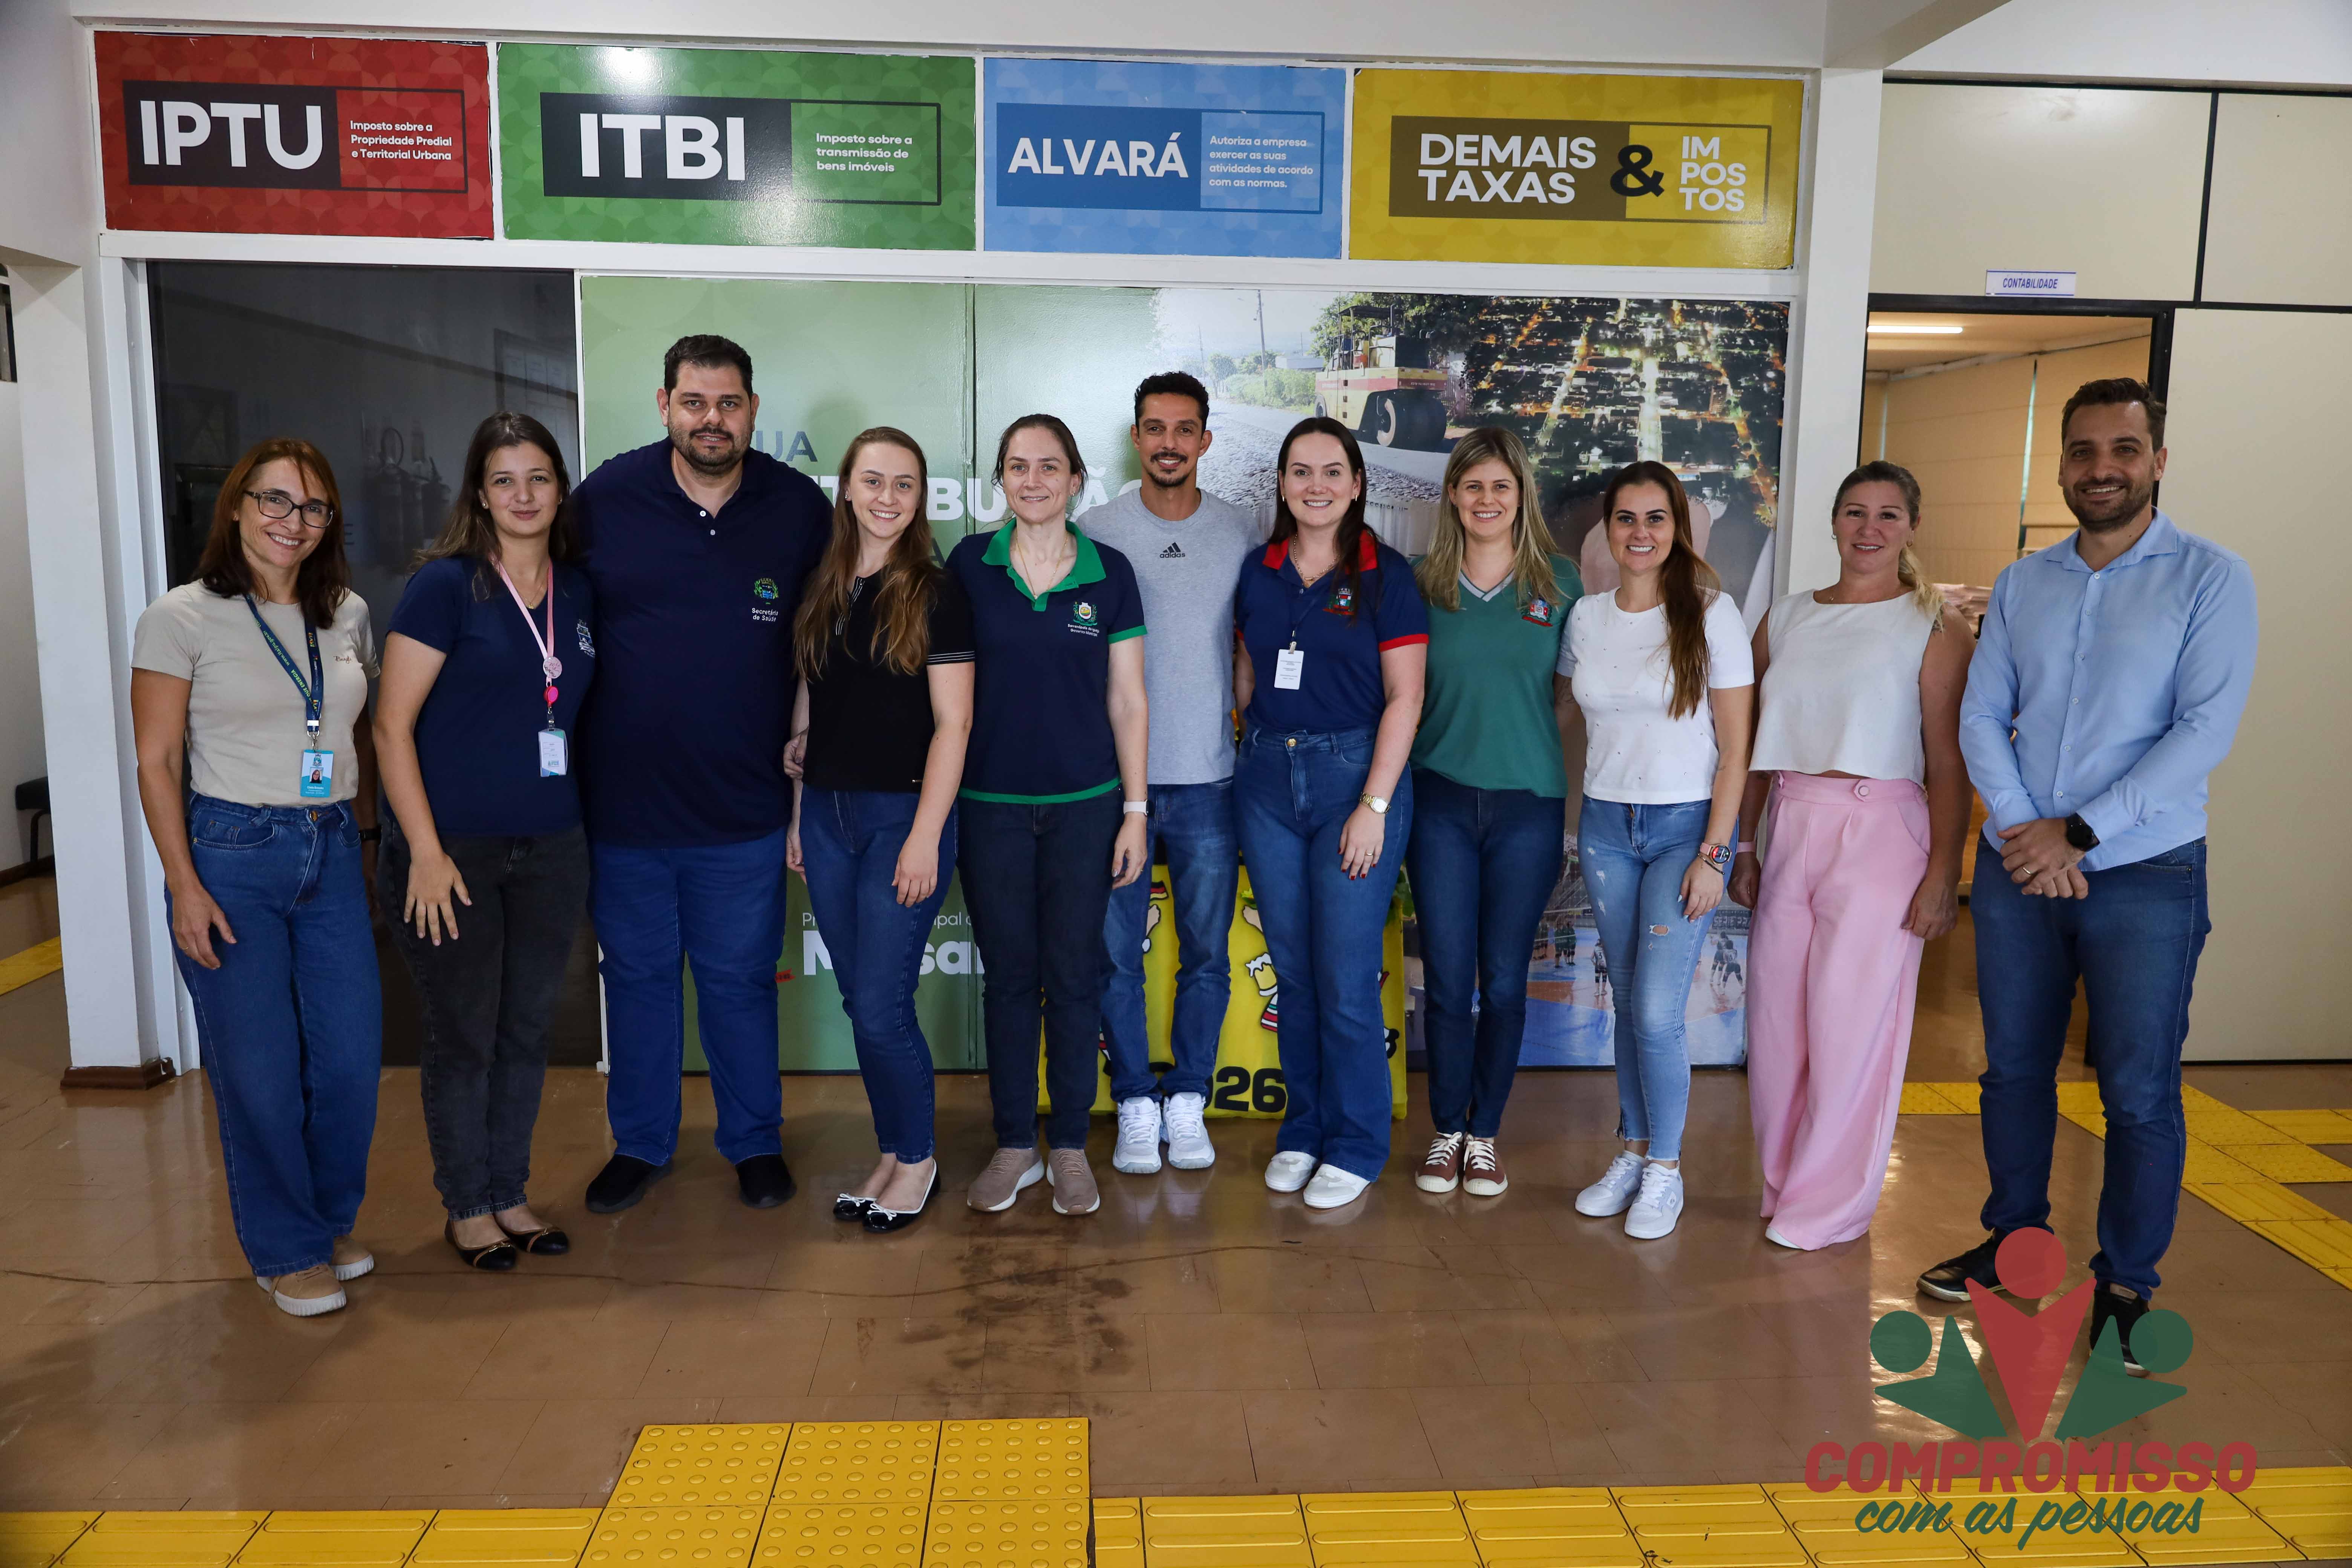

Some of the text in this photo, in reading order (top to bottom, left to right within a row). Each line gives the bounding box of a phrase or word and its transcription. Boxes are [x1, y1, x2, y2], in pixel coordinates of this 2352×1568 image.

[141, 101, 322, 169] IPTU
[351, 121, 392, 132] Imposto
[395, 122, 423, 131] sobre
[351, 135, 452, 146] Propriedade Predial
[816, 133, 865, 144] Imposto
[868, 135, 902, 144] sobre
[1210, 136, 1251, 145] Autoriza
[1263, 139, 1307, 148] empresa
[360, 149, 410, 159] Territorial
[413, 150, 451, 160] Urbana
[580, 113, 745, 182] ITBI
[816, 148, 908, 158] transmissão de
[1008, 133, 1188, 178] ALVARÁ
[1421, 134, 1596, 168] DEMAIS
[1682, 136, 1720, 159] IM
[817, 161, 894, 172] bens imóveis
[1209, 164, 1313, 174] atividades de acordo
[1607, 142, 1664, 199] &
[1681, 162, 1746, 186] POS
[1418, 170, 1575, 204] TAXAS
[1679, 188, 1745, 213] TOS
[2003, 278, 2058, 288] CONTABILIDADE
